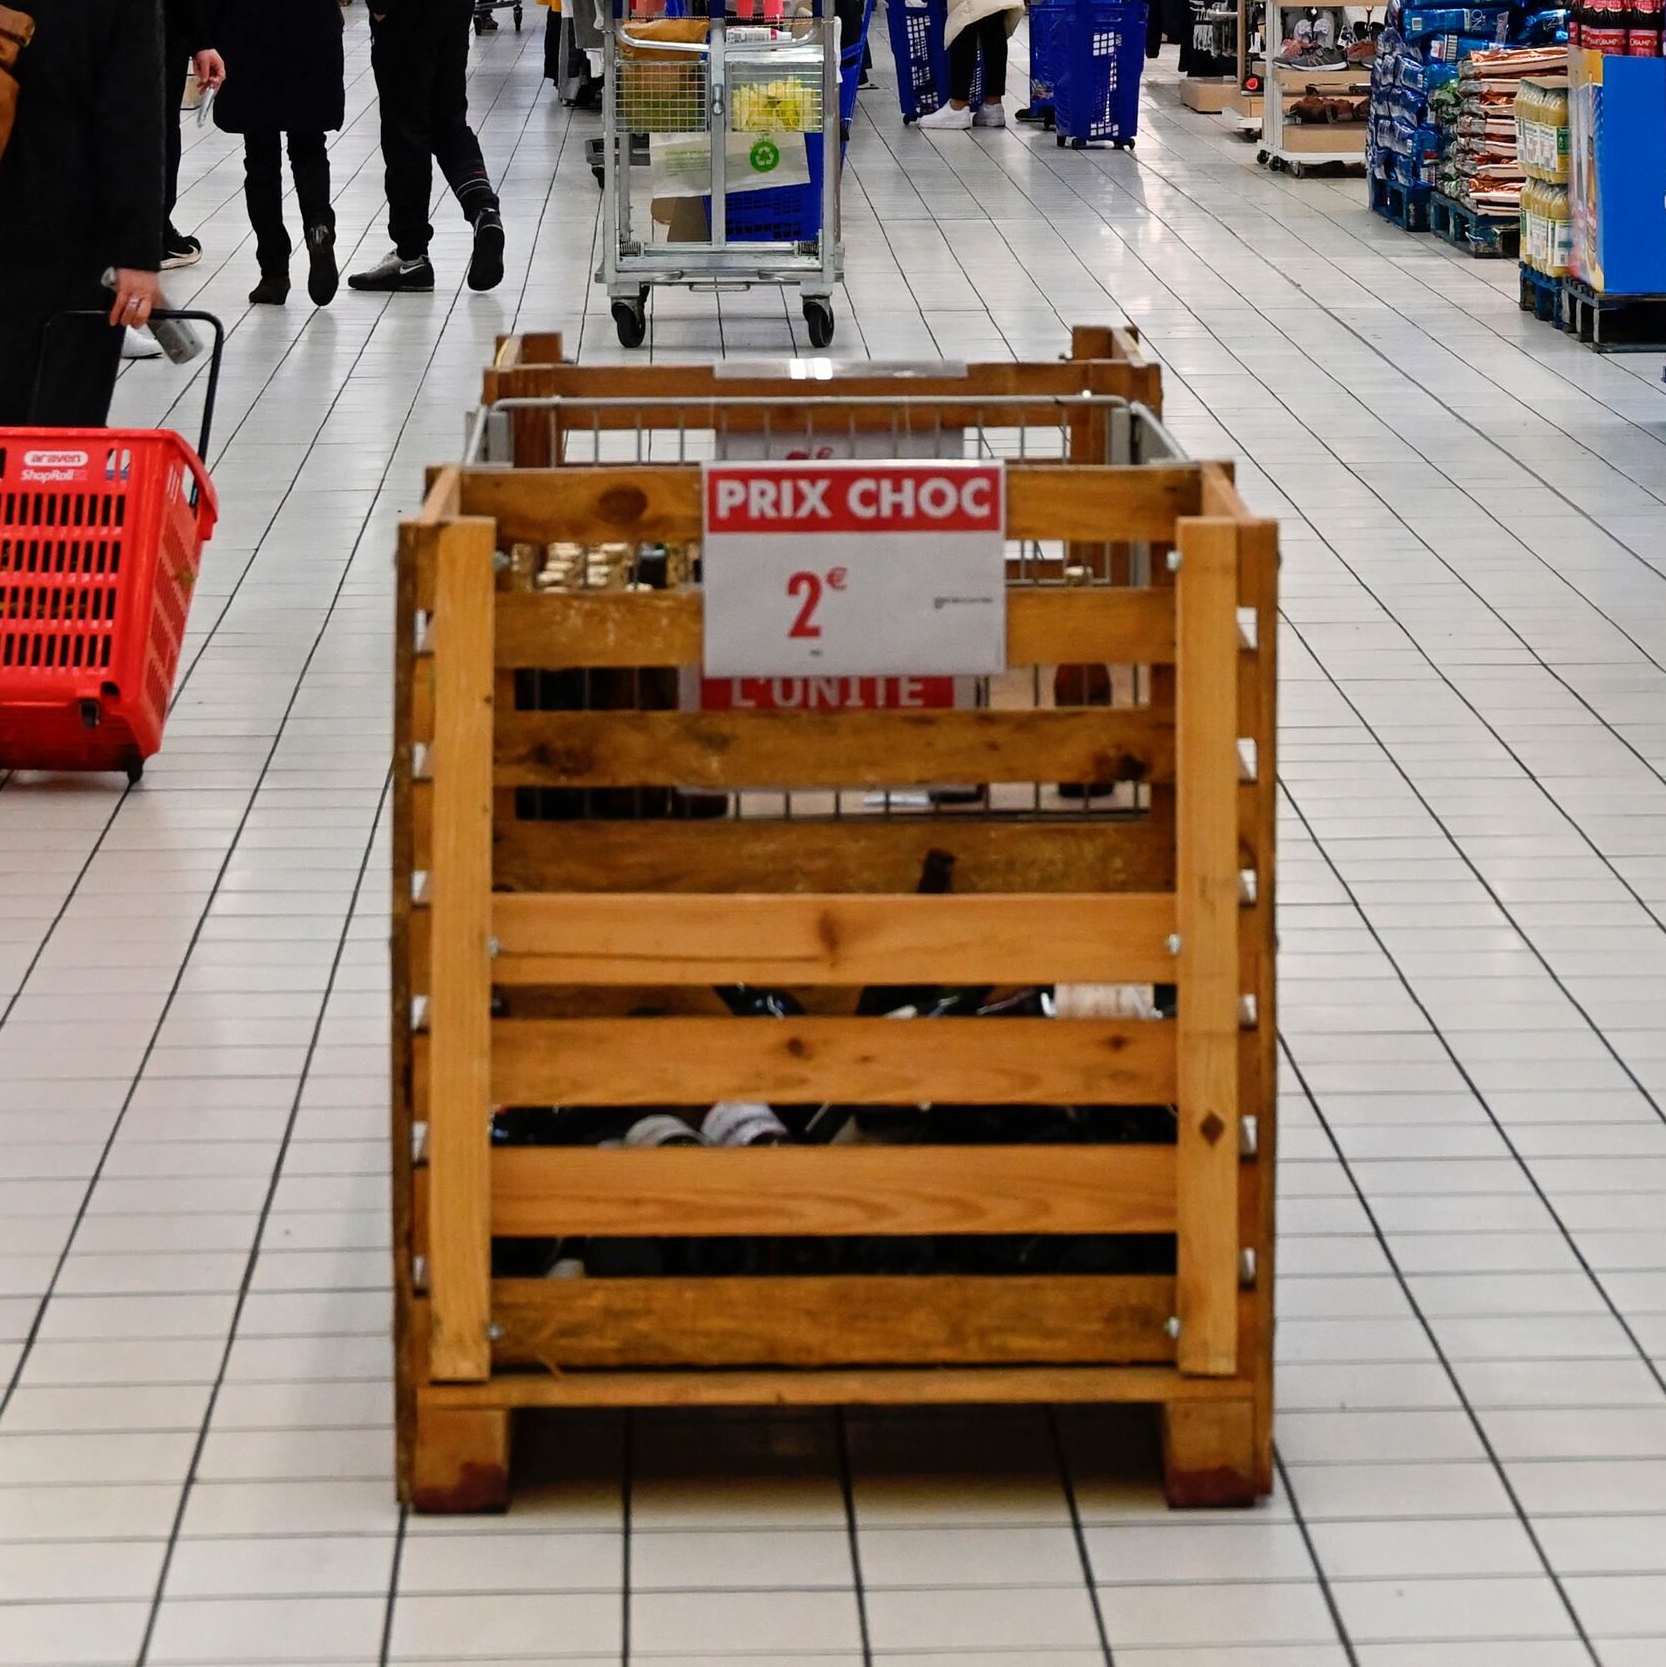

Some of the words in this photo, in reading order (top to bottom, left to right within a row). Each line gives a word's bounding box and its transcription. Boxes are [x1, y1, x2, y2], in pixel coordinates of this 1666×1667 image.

[30, 453, 82, 463] araven
[715, 478, 832, 520] PRIX
[846, 477, 992, 520] CHOC
[787, 567, 848, 639] 2€
